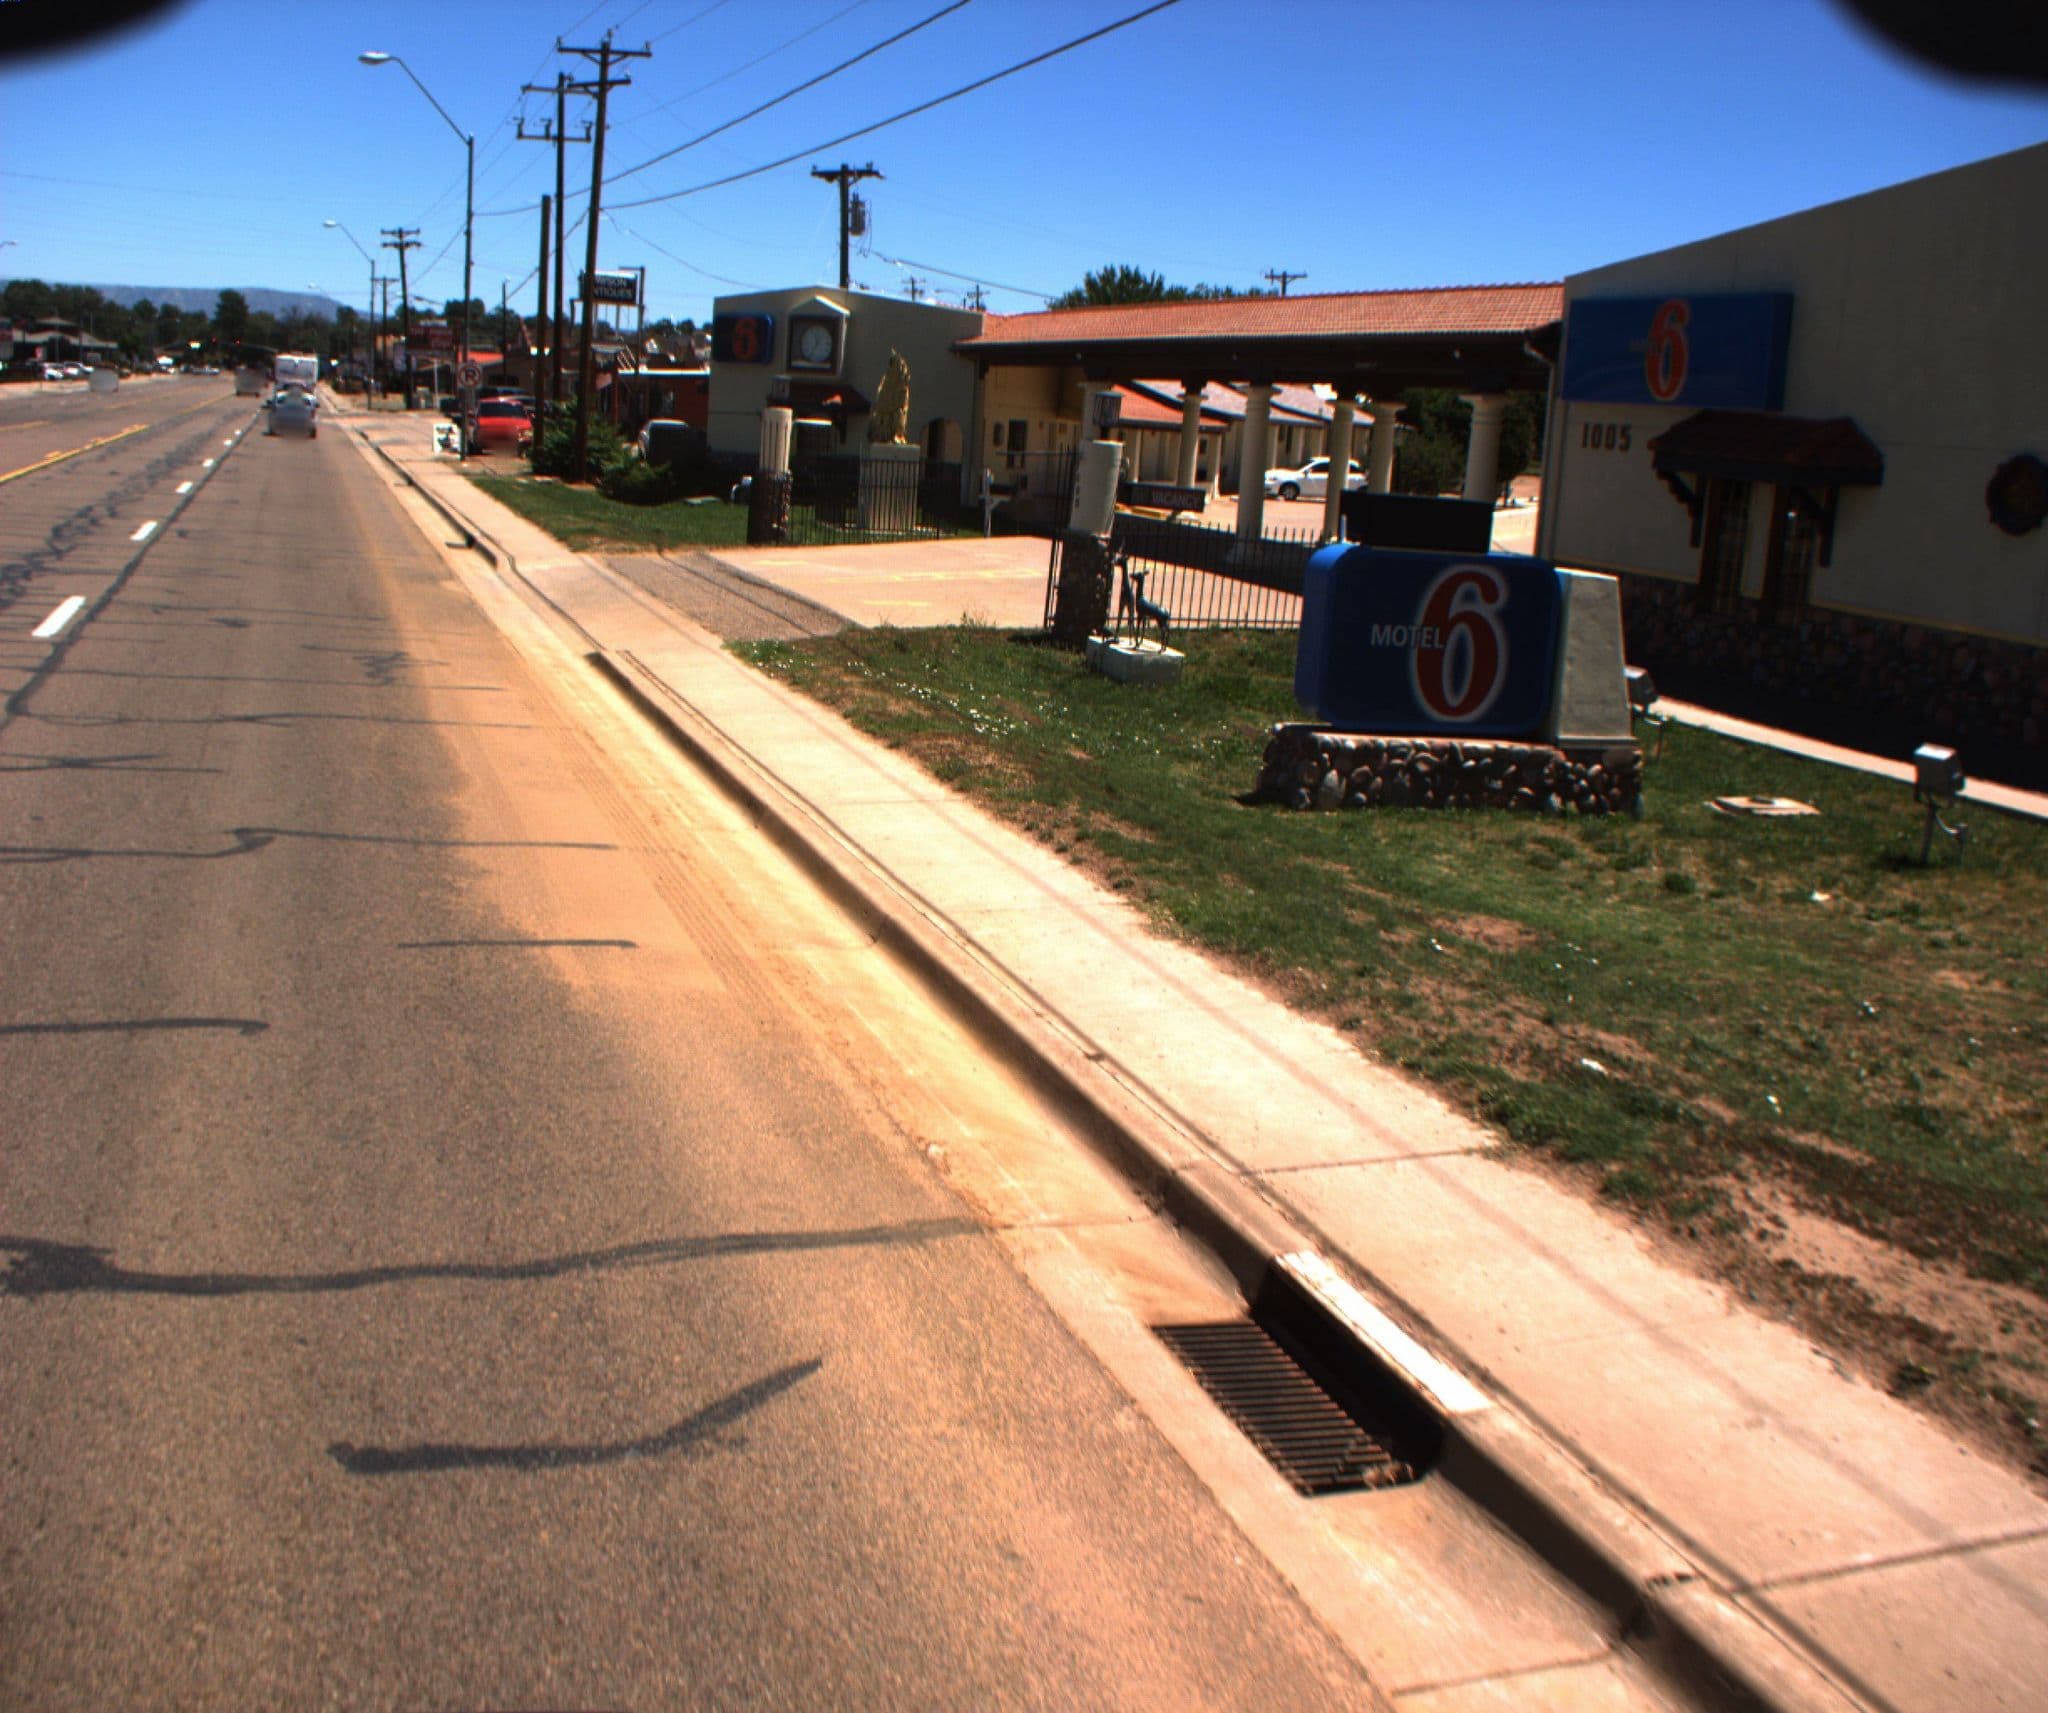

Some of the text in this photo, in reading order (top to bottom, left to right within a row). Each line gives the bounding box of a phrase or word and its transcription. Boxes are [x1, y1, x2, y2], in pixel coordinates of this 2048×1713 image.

[1645, 299, 1691, 402] 6
[1582, 422, 1632, 451] 1005
[1370, 564, 1510, 724] MOTEL 6
